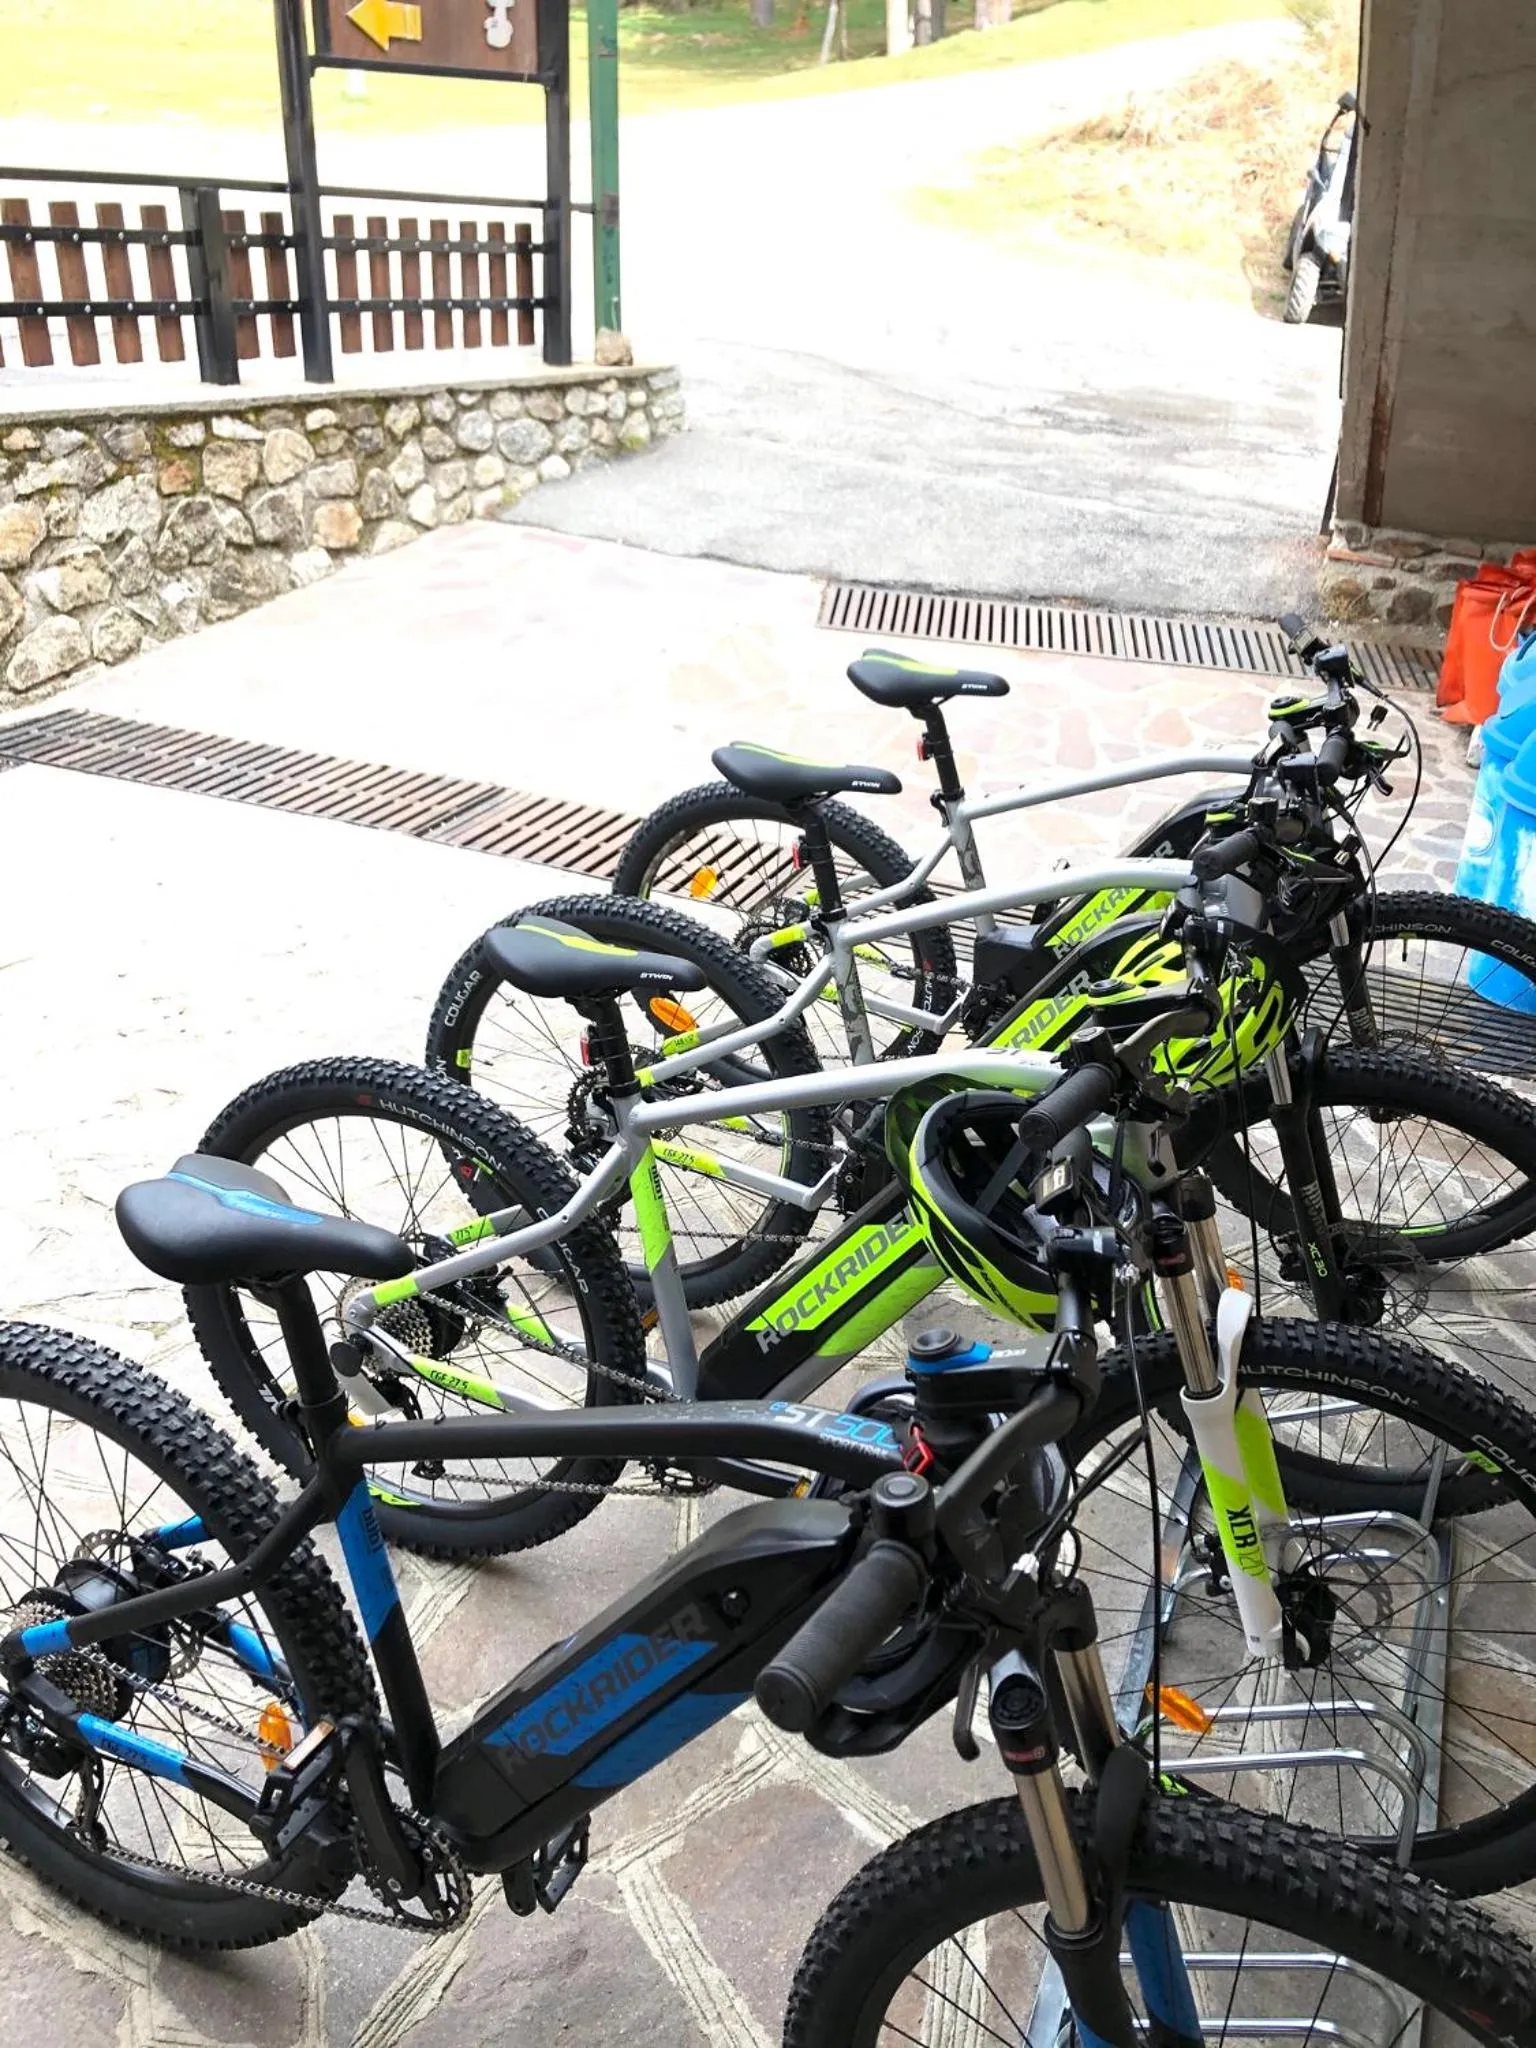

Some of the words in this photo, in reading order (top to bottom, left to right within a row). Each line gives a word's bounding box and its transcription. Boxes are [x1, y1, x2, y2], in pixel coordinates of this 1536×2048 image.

[444, 969, 483, 1028] COUGAR
[1011, 969, 1093, 1050] RIDER
[497, 1602, 709, 1776] ROCKRIDER
